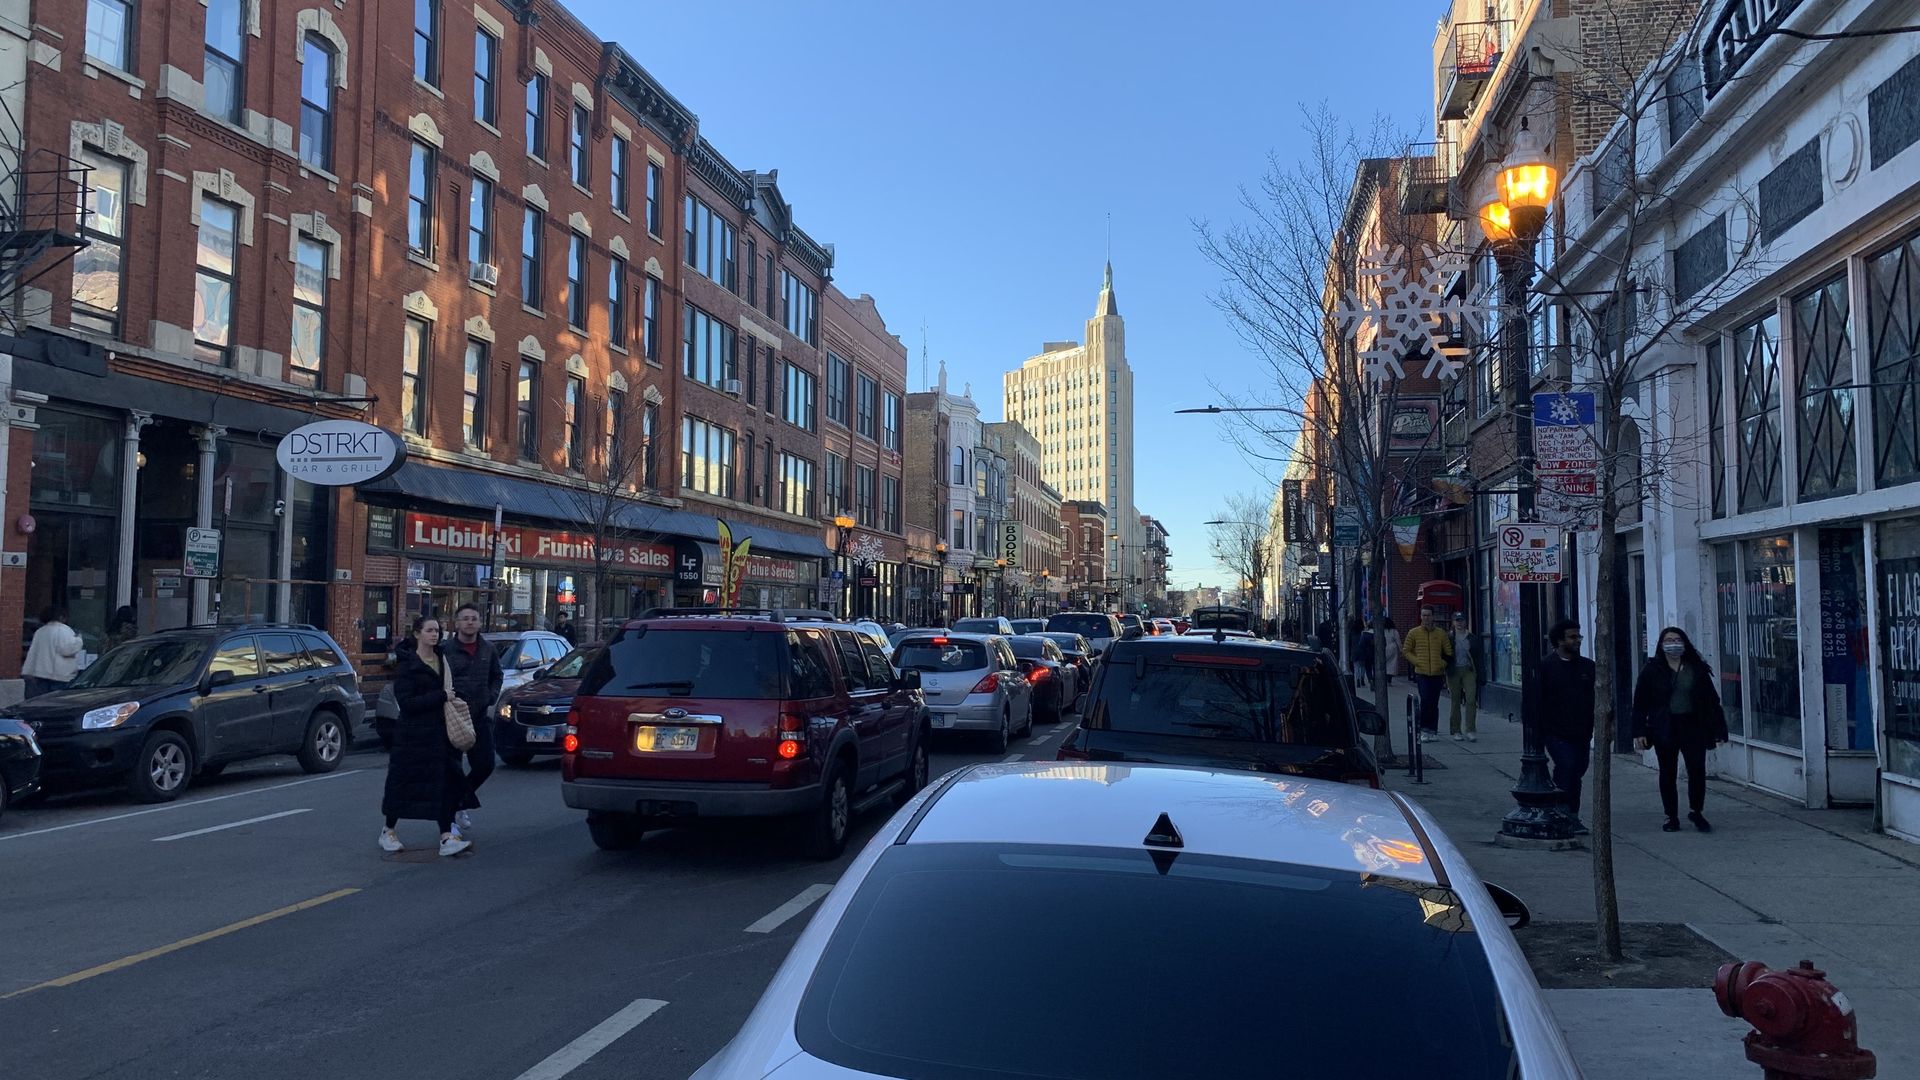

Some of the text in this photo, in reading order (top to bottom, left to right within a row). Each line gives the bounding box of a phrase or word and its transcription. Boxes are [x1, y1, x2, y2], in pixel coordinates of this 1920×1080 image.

[290, 431, 383, 455] DSTRKT
[292, 463, 380, 474] BAR & GRILL
[414, 520, 521, 553] Lubinski
[628, 546, 670, 567] Sales
[1005, 525, 1017, 566] BOOKS
[681, 554, 697, 571] LF
[746, 560, 796, 579] Value Service
[679, 571, 699, 580] 1550
[1503, 573, 1523, 581] TOW
[1725, 621, 1776, 660] MILAUKEE
